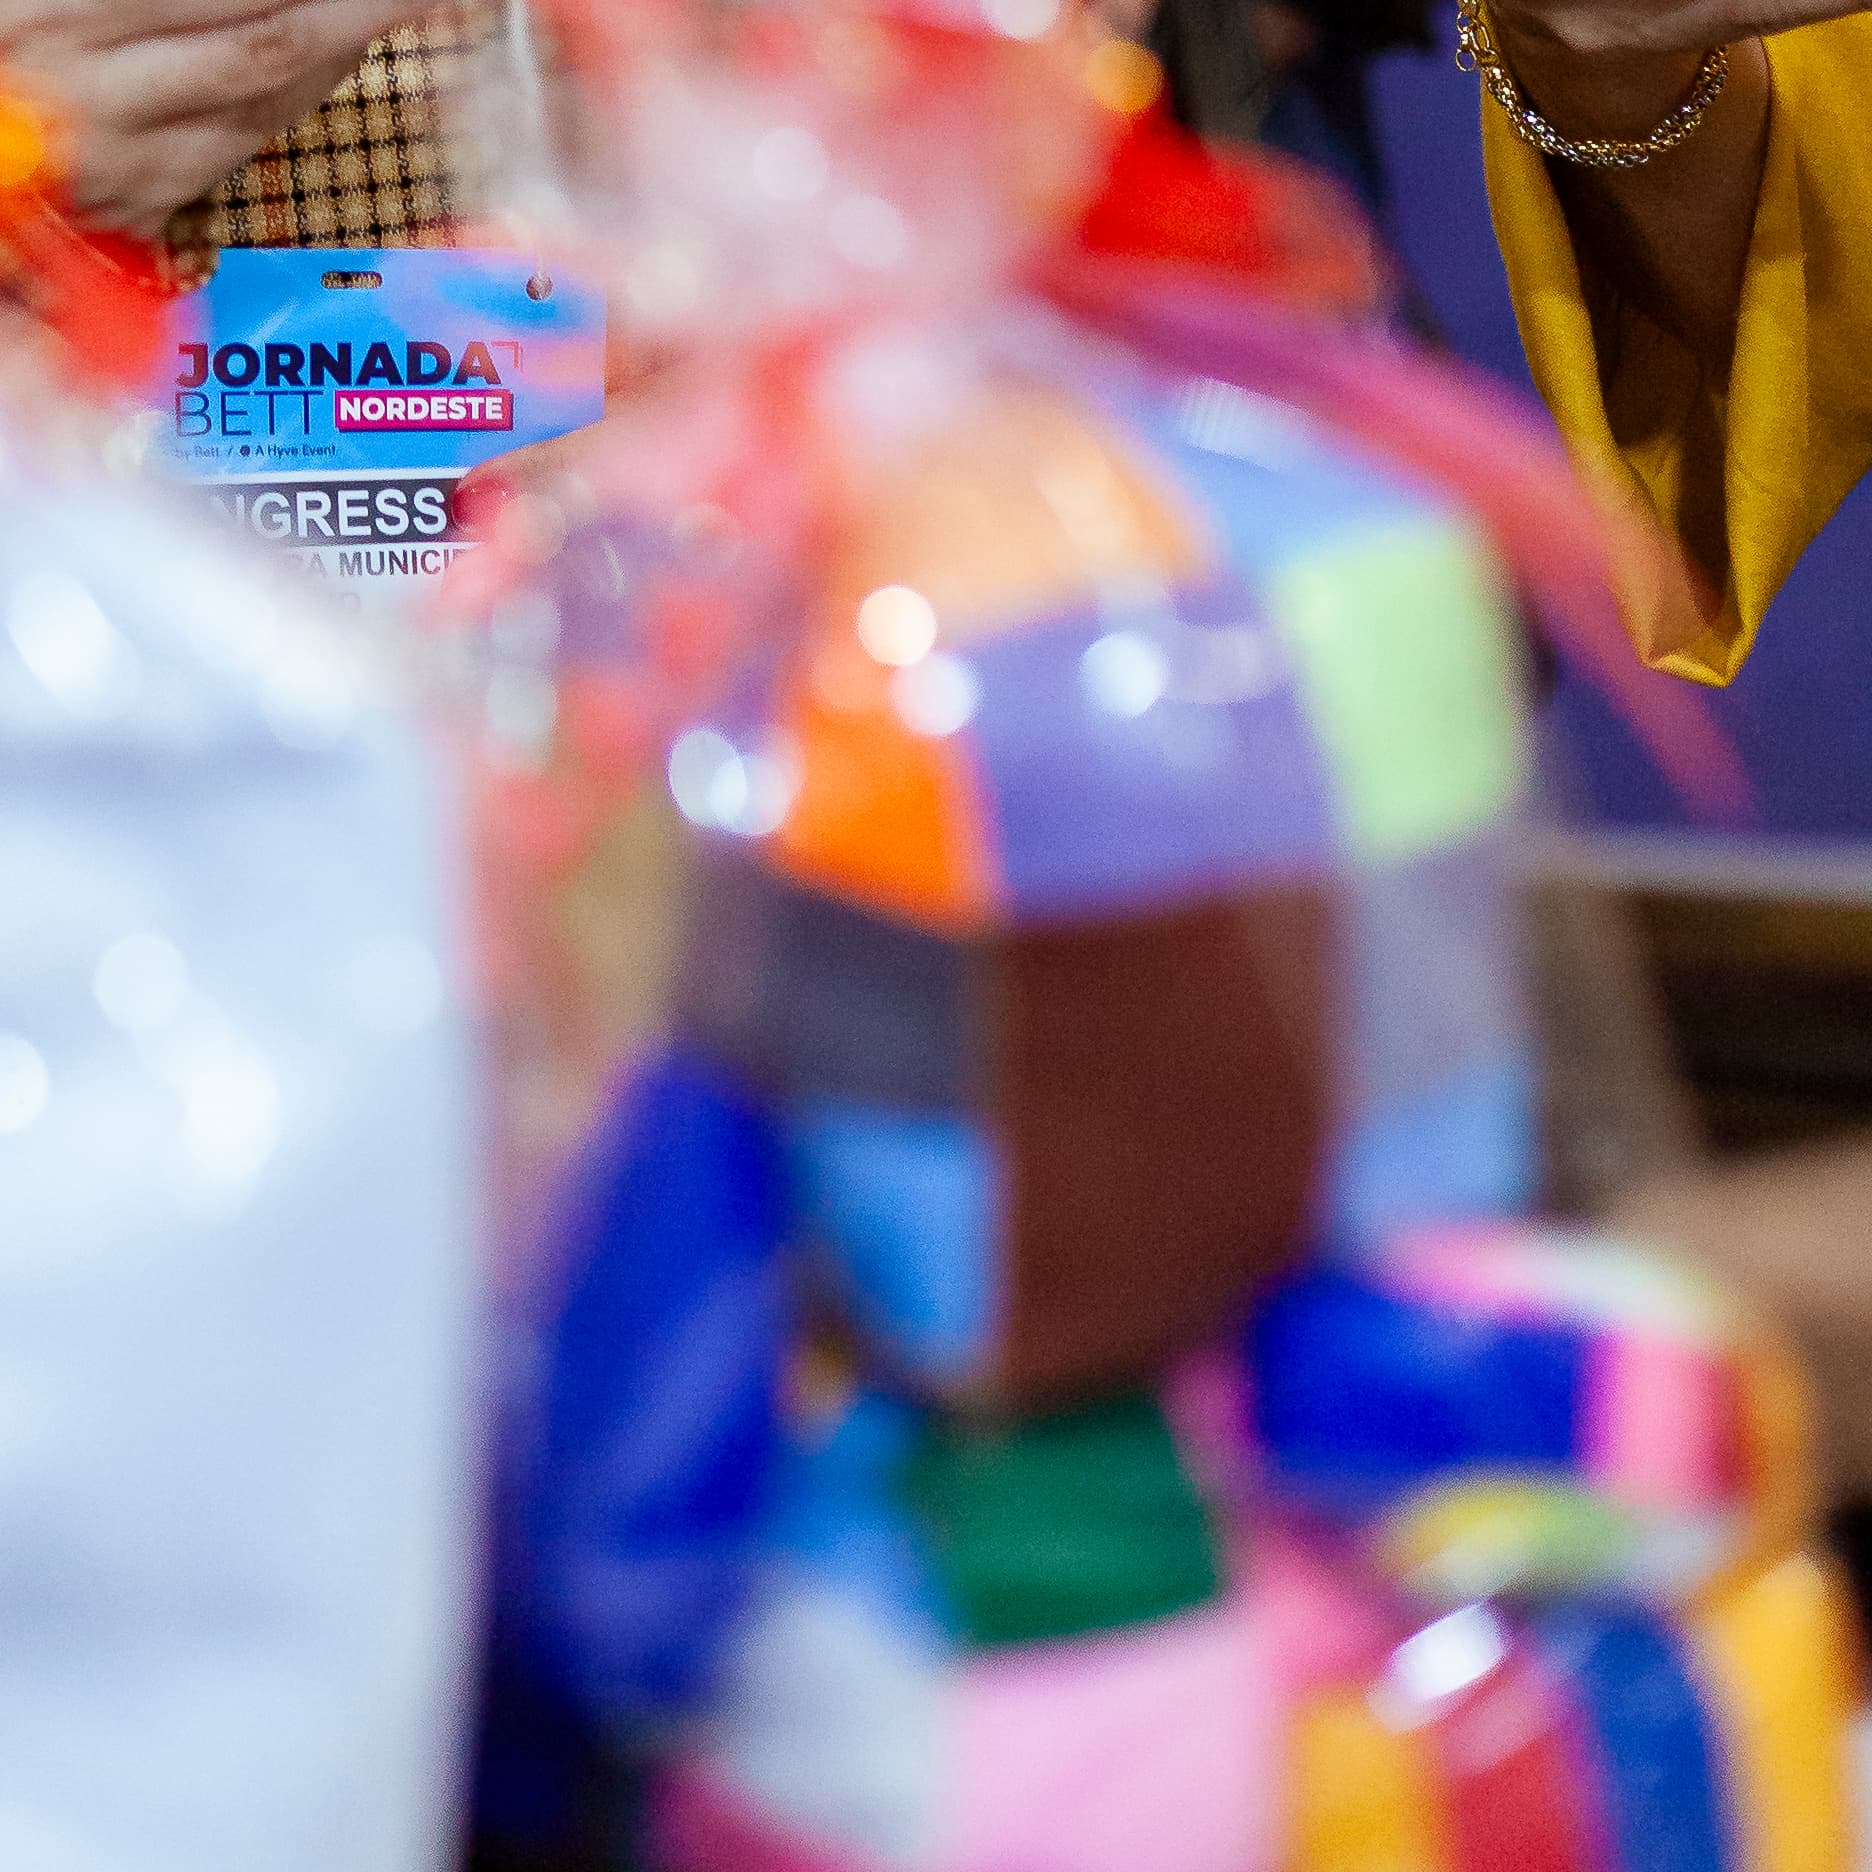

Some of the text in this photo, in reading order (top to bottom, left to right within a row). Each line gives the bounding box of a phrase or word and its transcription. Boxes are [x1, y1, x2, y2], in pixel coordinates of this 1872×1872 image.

[175, 341, 502, 389] JORNADA
[174, 389, 505, 438] BETT NORDESTE
